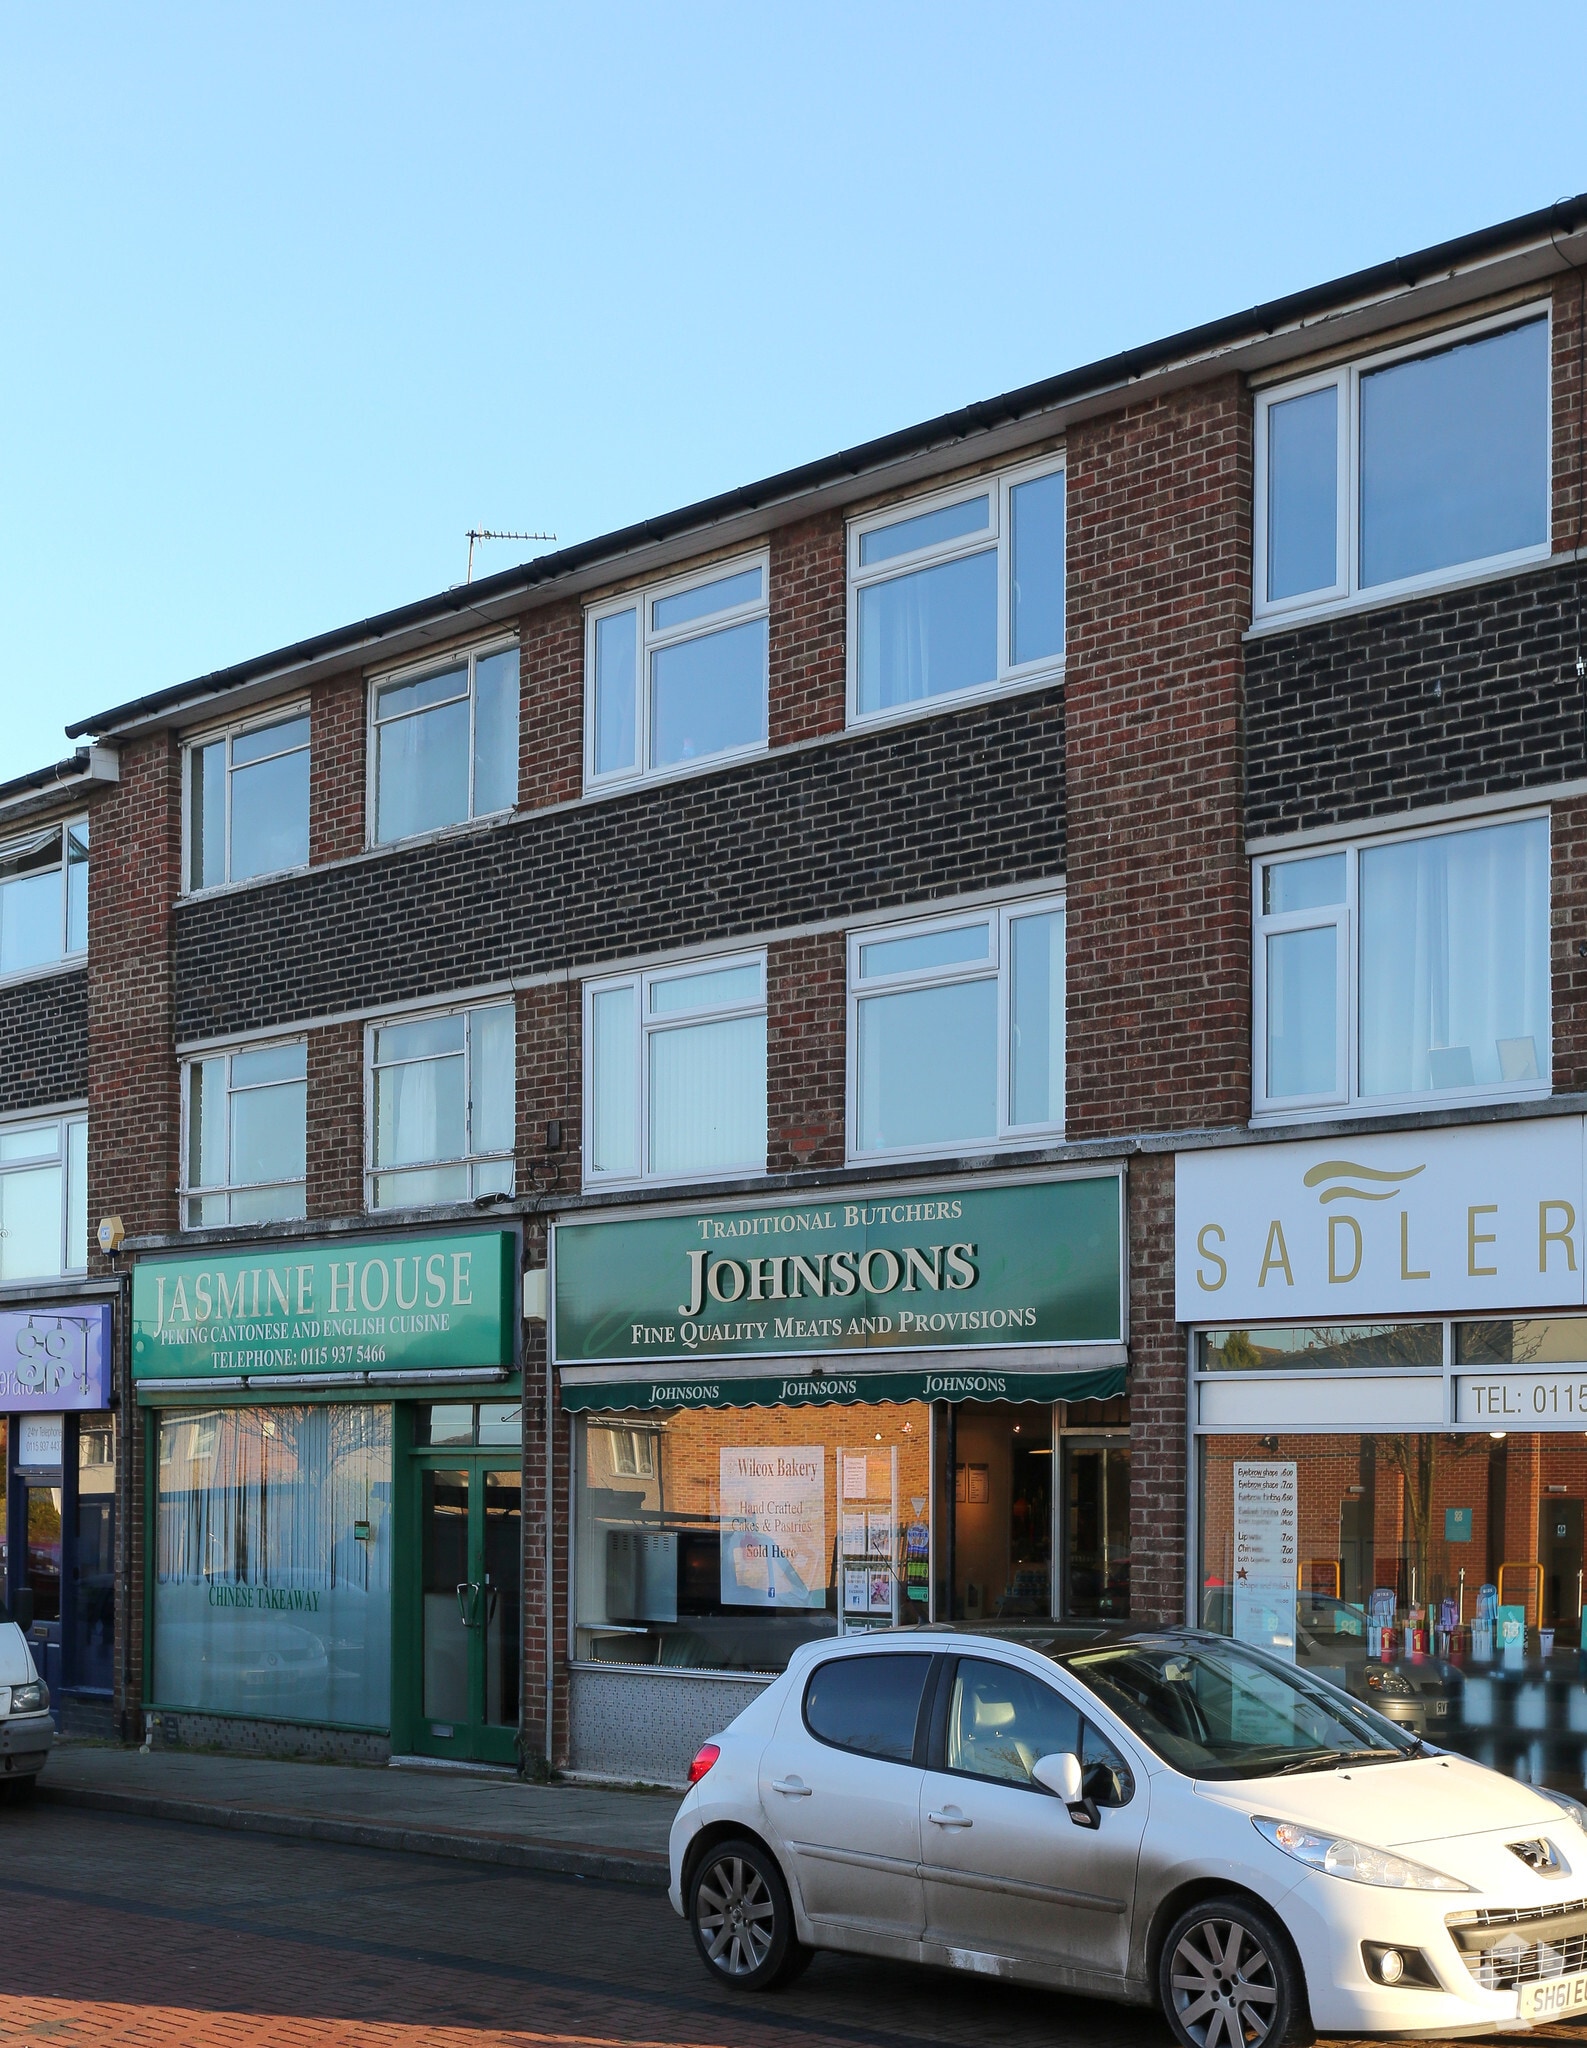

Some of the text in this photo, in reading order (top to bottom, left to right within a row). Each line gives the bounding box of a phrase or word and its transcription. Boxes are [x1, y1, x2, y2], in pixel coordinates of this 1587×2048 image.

[698, 1200, 963, 1240] TRADITIONAL BUTCHERS
[1196, 1199, 1578, 1292] SADLER
[678, 1243, 977, 1317] JOHNSONS
[154, 1252, 473, 1338] JASMINE HOUSE
[161, 1313, 450, 1345] PEKING CANTONESE AND ENGLISH CUISINE
[631, 1307, 1037, 1349] FINE QUALITY MEATS AND PROVISIONS
[212, 1344, 386, 1368] TELEPHONE: 0115 937 5466
[649, 1385, 719, 1402] JOHNSONS
[779, 1380, 857, 1399] JOHNSONS
[923, 1375, 1006, 1394] JOHNSONS
[1472, 1385, 1587, 1413] TEL: 0115
[738, 1458, 774, 1477] Wilcox
[777, 1457, 818, 1481] Bakery
[740, 1501, 803, 1515] Hand Crafted
[731, 1518, 812, 1533] Cakes & Pastries
[746, 1544, 796, 1559] Sold Here
[208, 1586, 320, 1612] CHINESE TAKEAWAY
